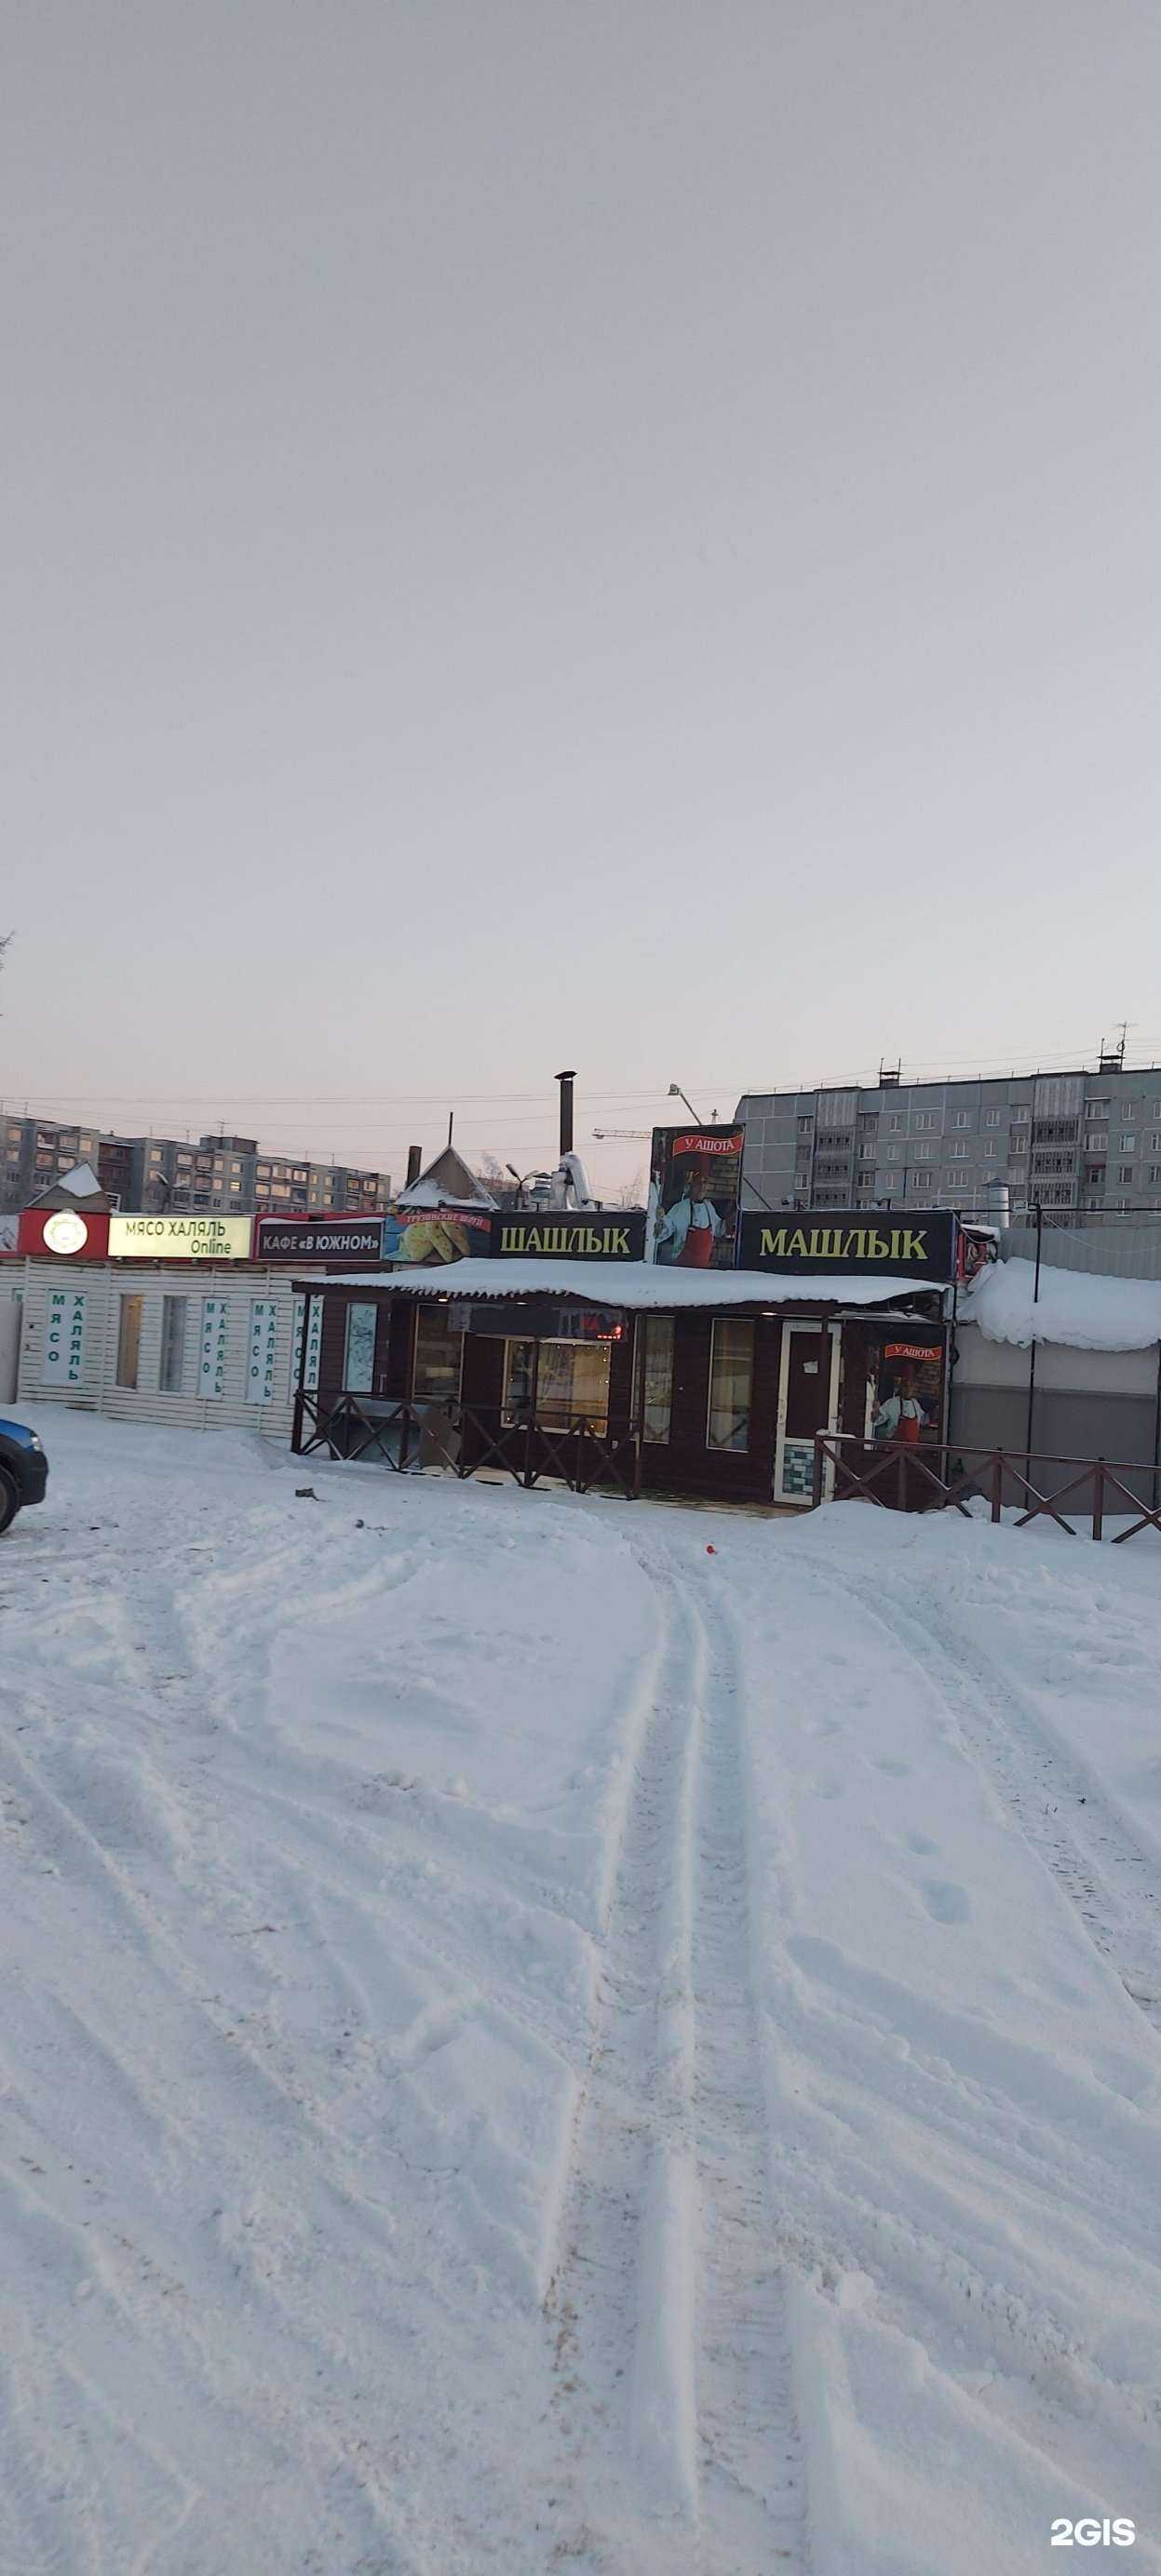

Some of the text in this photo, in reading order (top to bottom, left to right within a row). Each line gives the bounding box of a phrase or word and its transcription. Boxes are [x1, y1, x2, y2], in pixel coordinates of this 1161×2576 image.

[684, 1138, 735, 1151] У АШОТА
[126, 1221, 225, 1237] МЯСО ХАЛЯЛЬ
[191, 1239, 232, 1254] Online
[263, 1235, 379, 1250] КАФЕ «В ЮЖНОМ»
[500, 1227, 631, 1254] ШАШЛЫК
[759, 1228, 928, 1260] МАШЛЫК
[47, 1295, 65, 1362] МЯСО
[68, 1295, 85, 1380] ХАЛЯЛЬ
[203, 1303, 215, 1374] МЯСО
[214, 1303, 226, 1392] ХАЛЯЛЬ
[250, 1305, 263, 1377] МЯСО
[263, 1305, 277, 1397] ХАЛЯЛЬ
